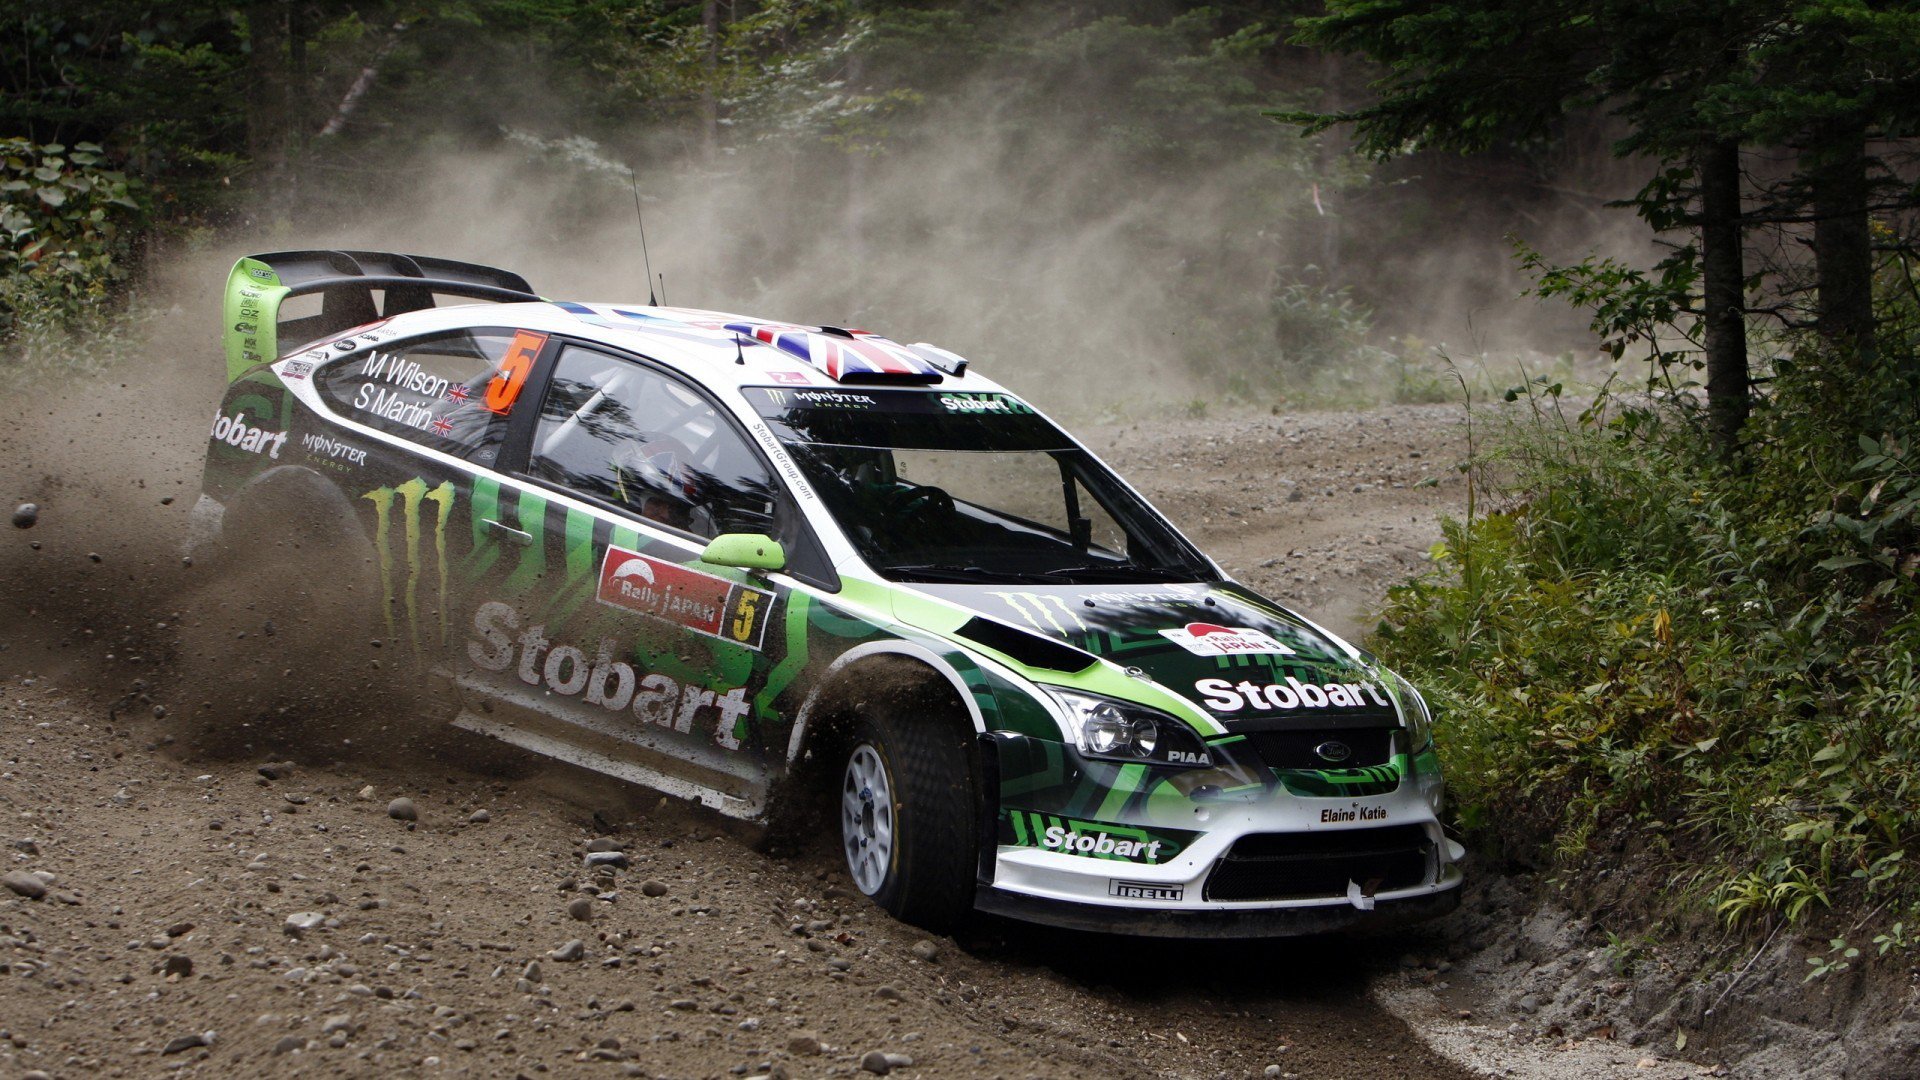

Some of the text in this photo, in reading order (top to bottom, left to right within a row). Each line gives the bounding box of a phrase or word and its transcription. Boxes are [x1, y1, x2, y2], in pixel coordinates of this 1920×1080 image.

[362, 350, 449, 399] M Wilson
[484, 330, 549, 412] 5
[354, 382, 433, 431] S Martin
[940, 396, 1010, 411] Stobart
[753, 423, 813, 500] StobartGroup.com
[621, 580, 661, 607] Rally
[733, 590, 760, 641] 5
[467, 601, 751, 750] Stobart
[1195, 676, 1389, 712] Stobart
[1167, 750, 1210, 764] PIAA
[1320, 806, 1387, 823] Elaine Katie
[1043, 826, 1162, 859] Stobart
[1109, 879, 1184, 901] PIRELLI
